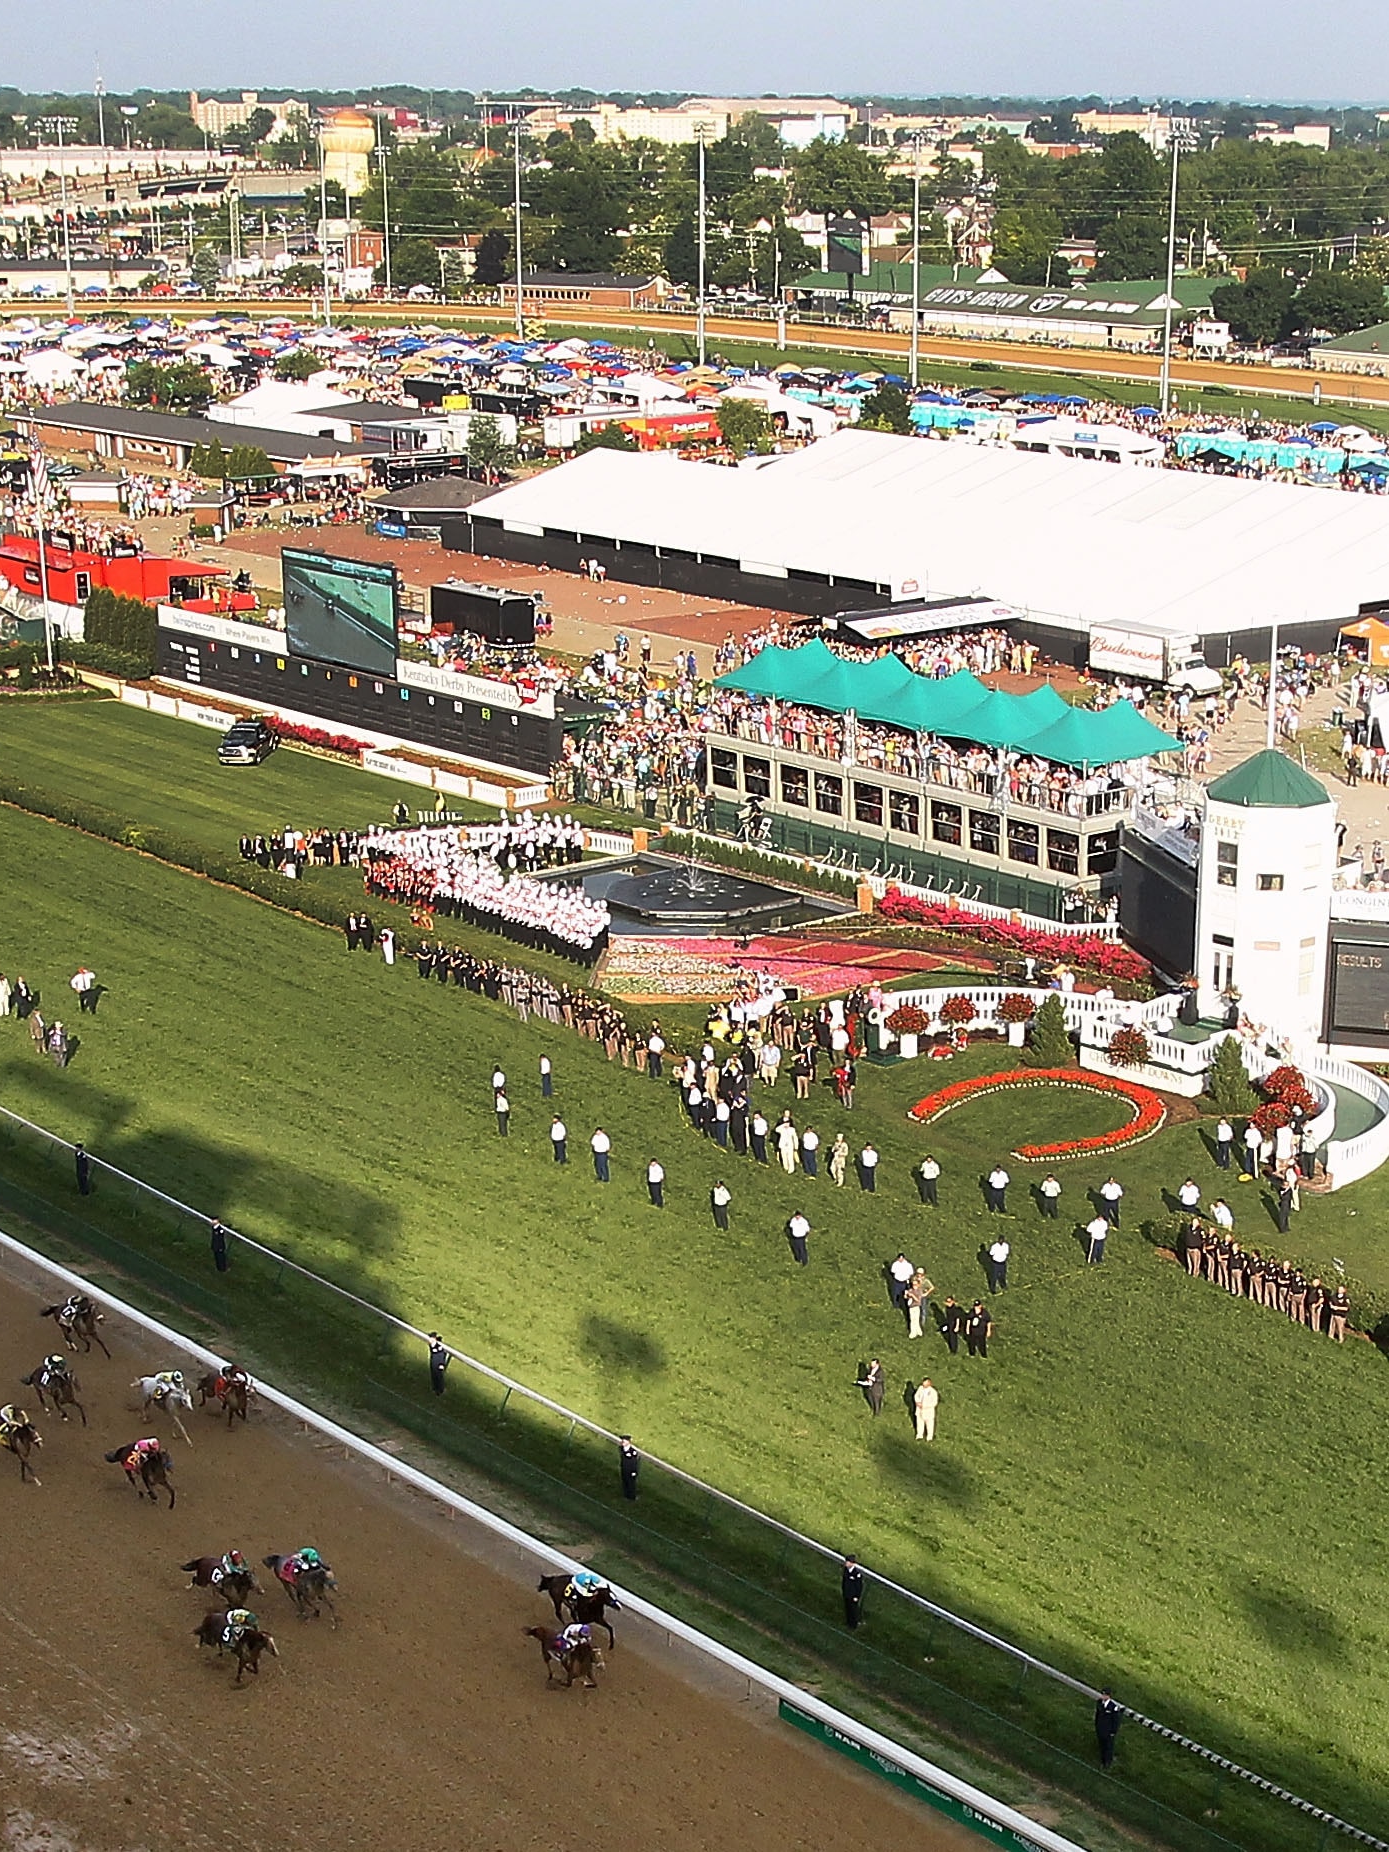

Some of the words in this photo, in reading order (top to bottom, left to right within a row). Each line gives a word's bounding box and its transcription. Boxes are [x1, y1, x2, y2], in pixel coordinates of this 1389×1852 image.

[1062, 300, 1140, 313] RAM
[1089, 636, 1163, 661] Budweiser
[403, 666, 438, 689] Kentucky
[441, 674, 463, 694] Derby
[467, 681, 507, 702] Presented
[1337, 953, 1382, 968] RESULTS
[564, 1583, 574, 1597] 6
[222, 1626, 230, 1641] 5
[835, 1730, 860, 1750] RAM
[974, 1811, 1003, 1832] RAM
